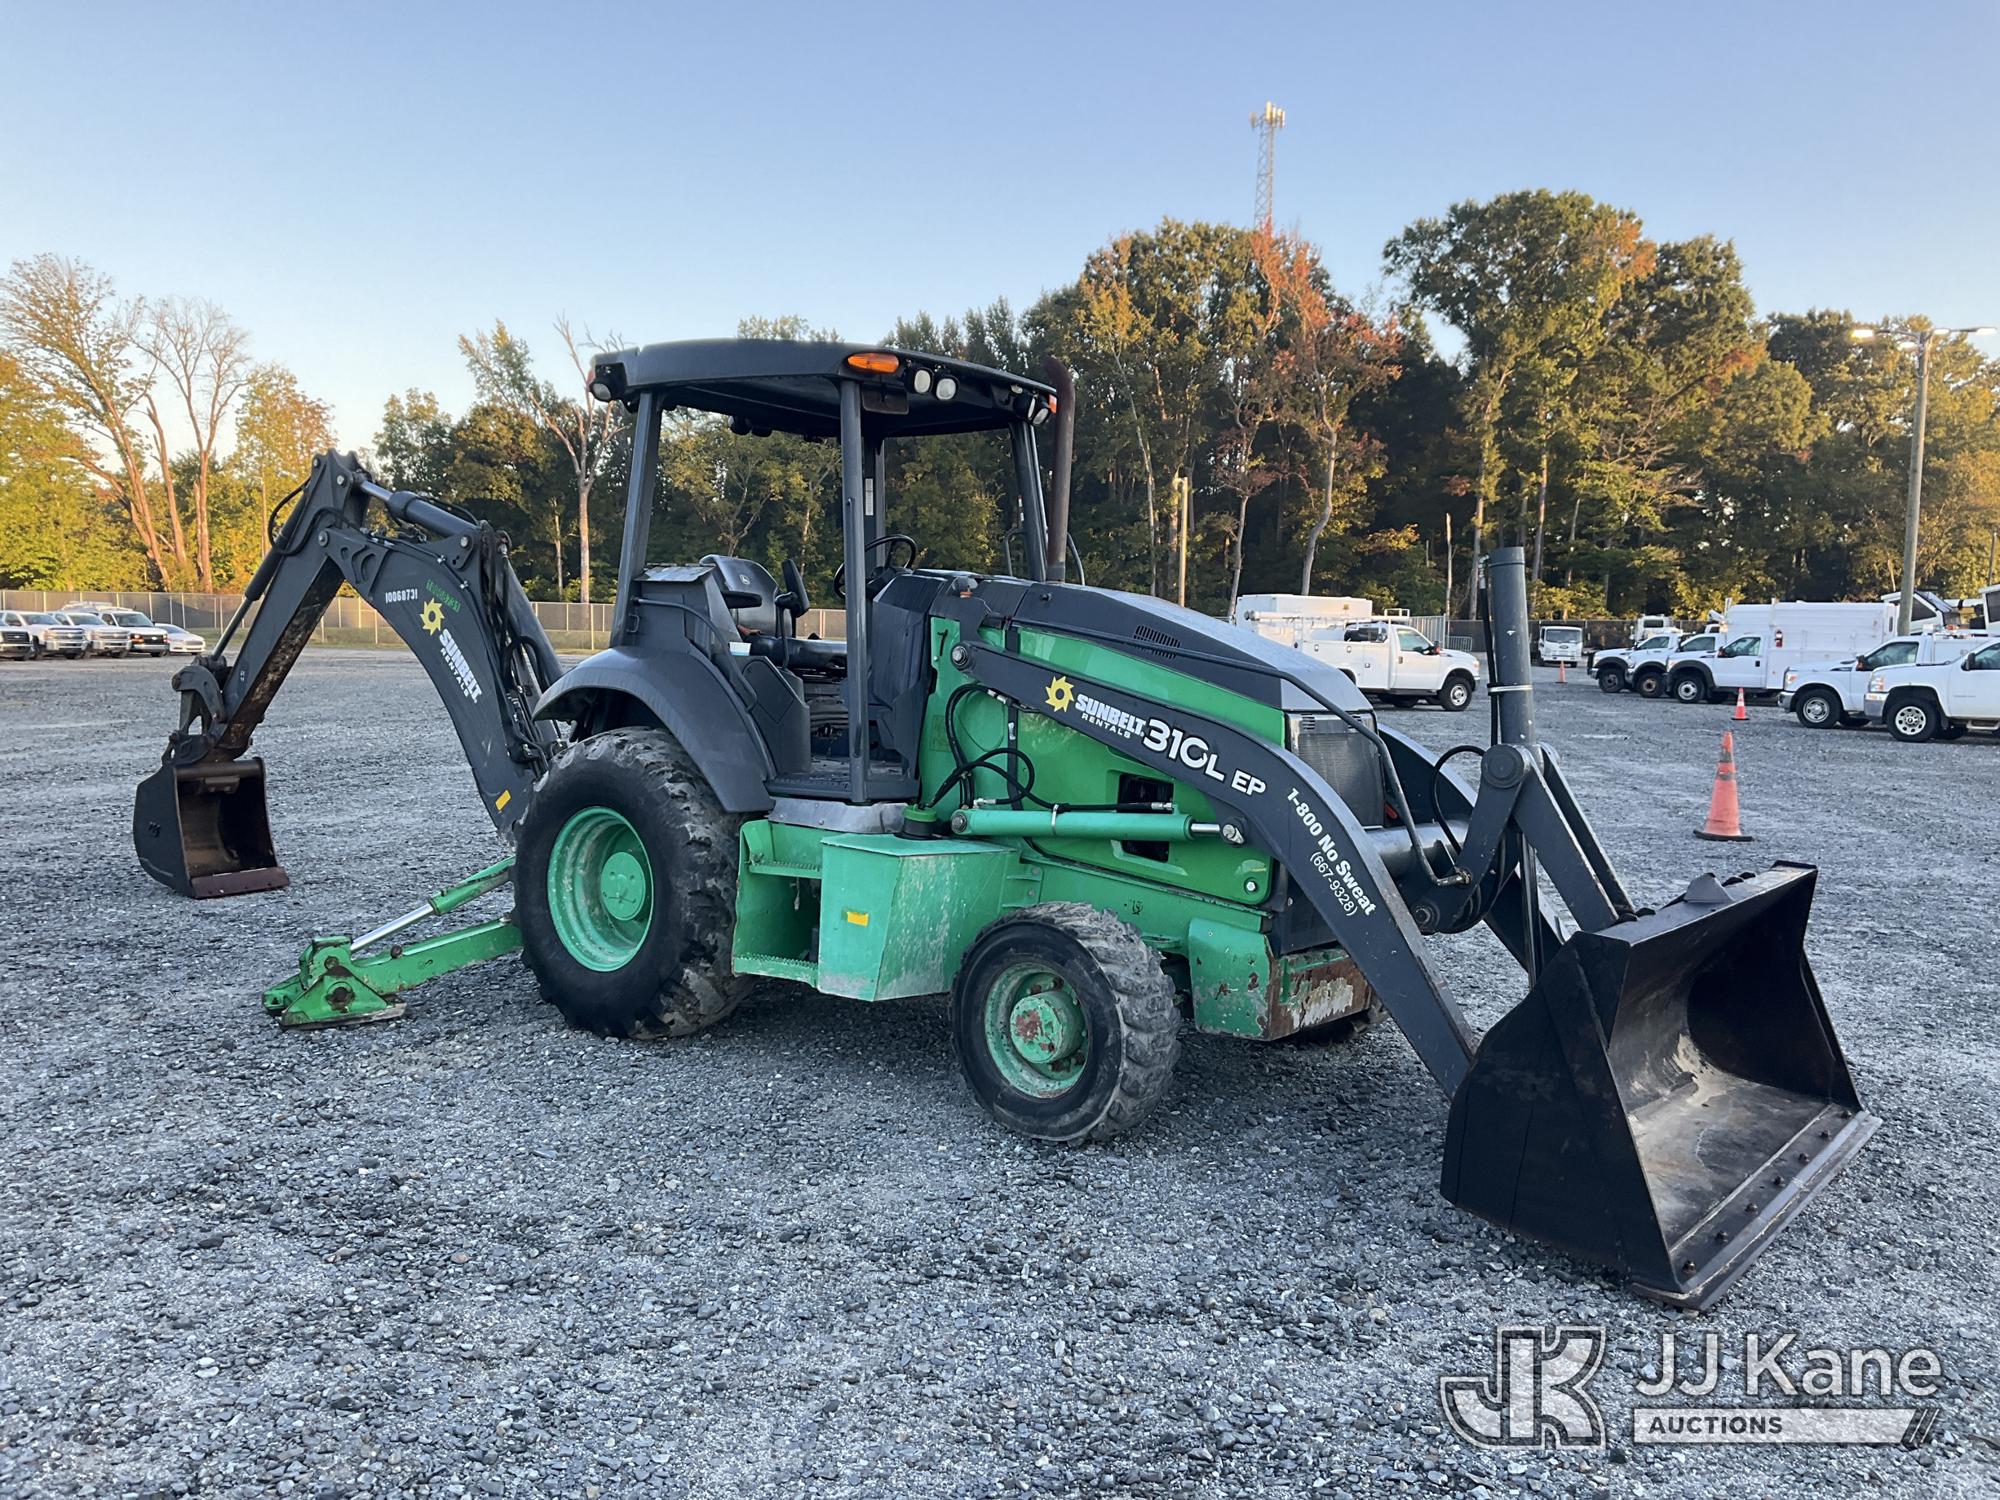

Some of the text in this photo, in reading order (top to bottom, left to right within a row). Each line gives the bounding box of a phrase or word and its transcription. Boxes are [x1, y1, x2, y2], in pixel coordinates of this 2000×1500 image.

[439, 628, 483, 703] SUNBELT
[1075, 693, 1147, 737] SUNBELT
[1081, 712, 1131, 739] RENTALS
[1231, 769, 1267, 796] EP
[1287, 787, 1377, 916] 1-800 No Sweat
[1309, 851, 1358, 916] (667-9328)
